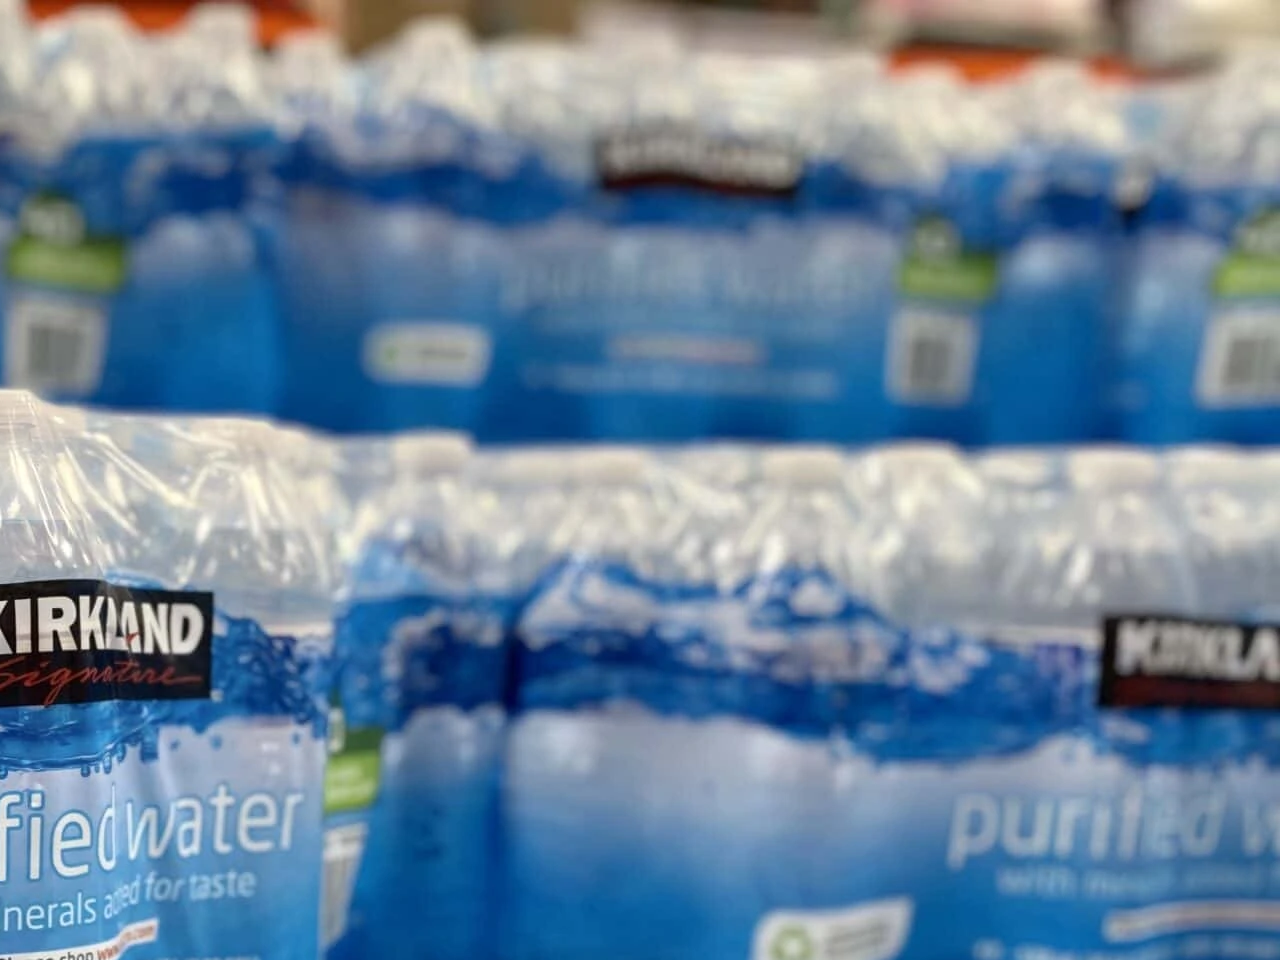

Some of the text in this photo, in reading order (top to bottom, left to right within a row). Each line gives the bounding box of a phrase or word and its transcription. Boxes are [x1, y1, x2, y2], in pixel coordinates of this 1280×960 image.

[125, 787, 305, 861] water
[144, 870, 185, 907] for
[189, 868, 258, 902] taste
